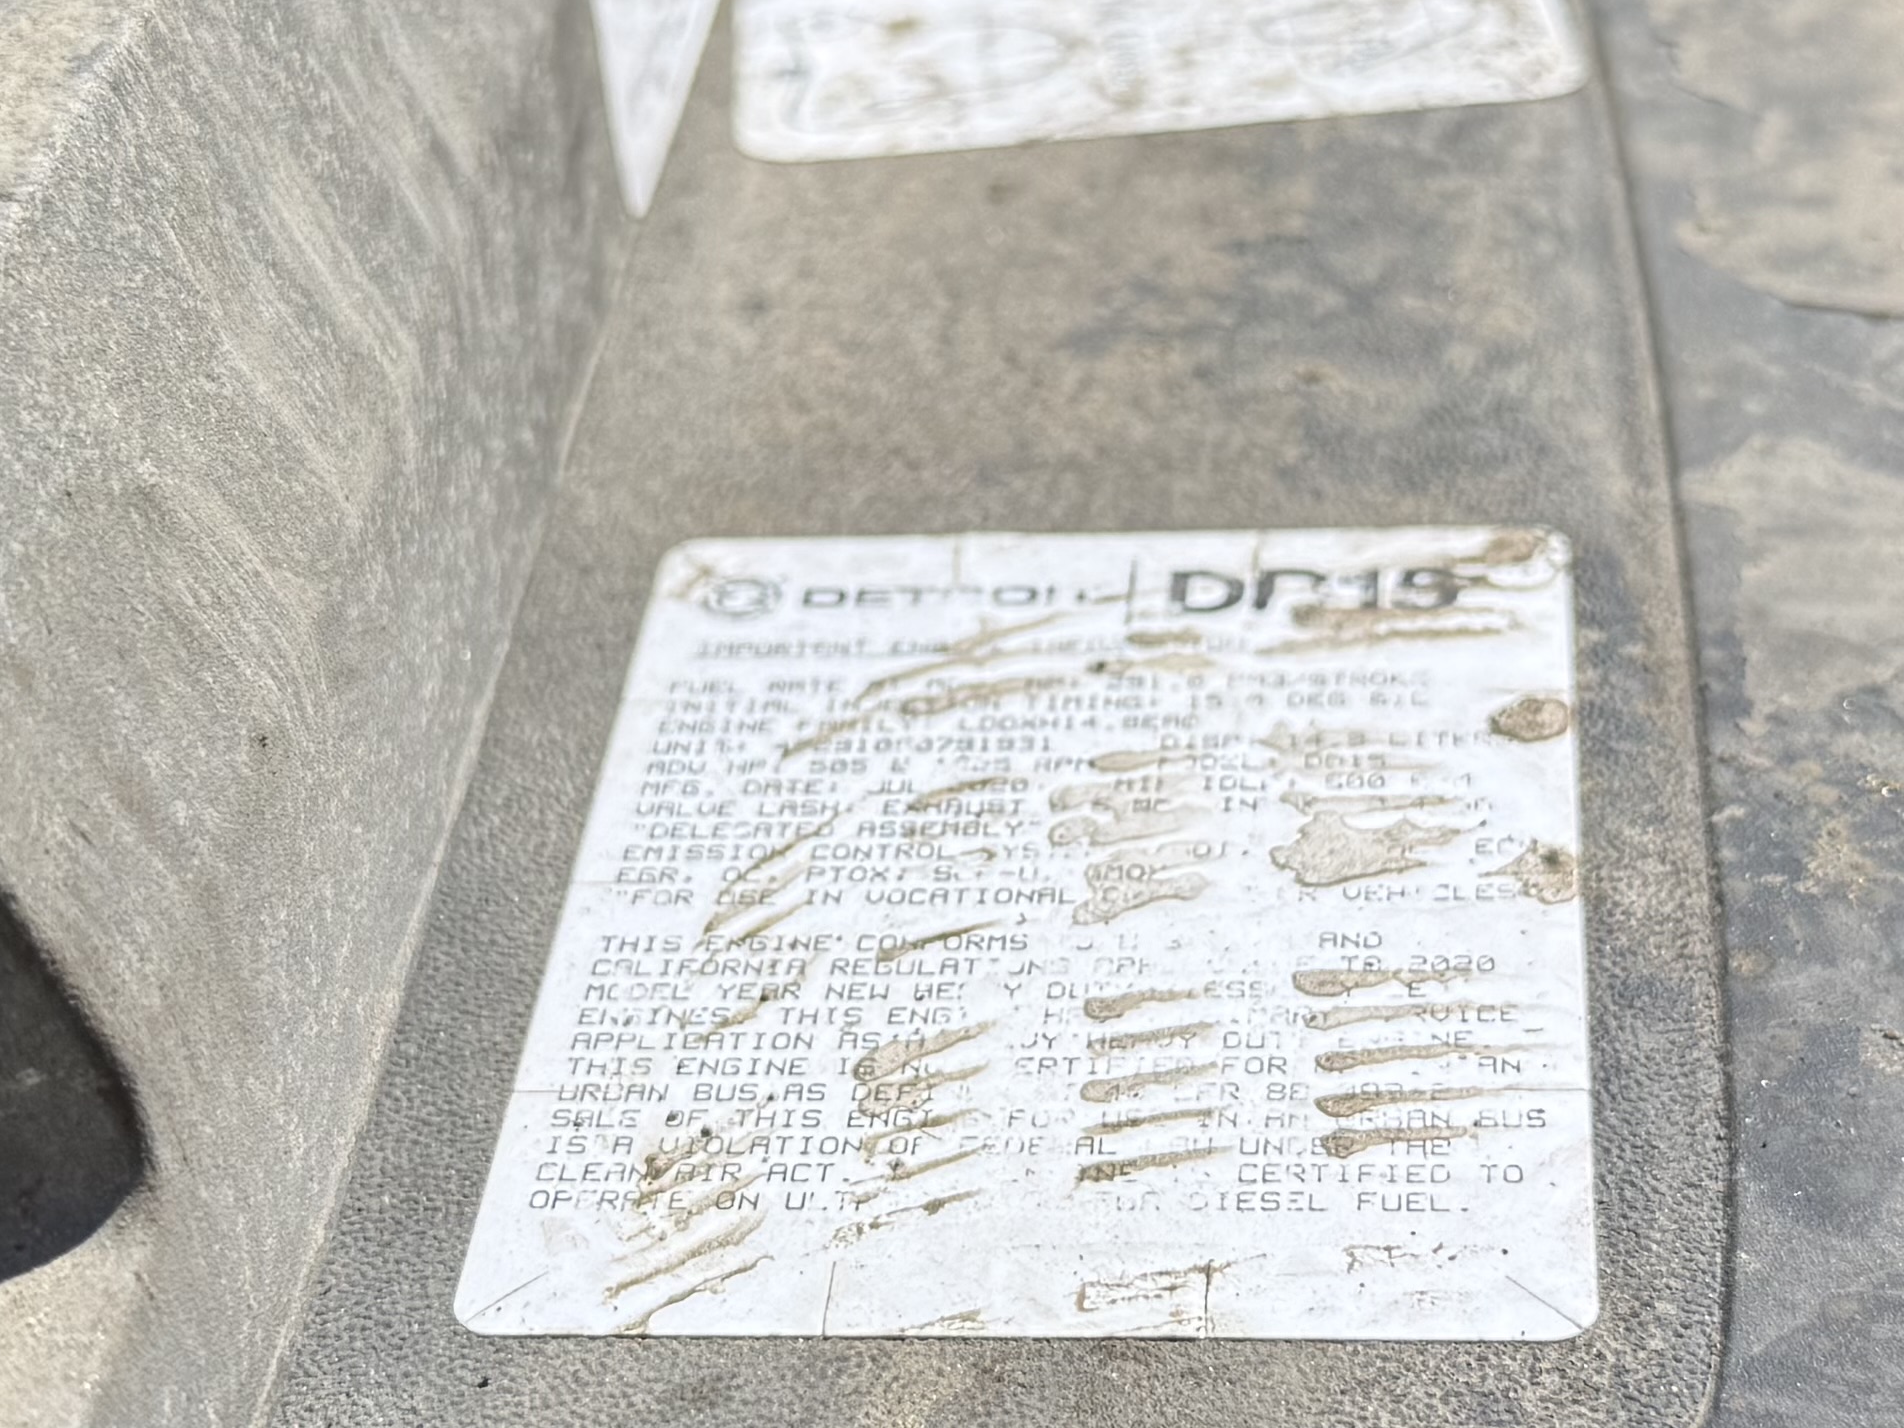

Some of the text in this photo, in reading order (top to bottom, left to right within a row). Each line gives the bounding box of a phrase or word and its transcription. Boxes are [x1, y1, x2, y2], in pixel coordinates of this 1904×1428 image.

[658, 718, 778, 734] ENGINE
[640, 778, 714, 797] MFG.
[635, 800, 737, 818] VALVE
[811, 842, 955, 861] CONTROL
[806, 887, 843, 905] IN
[865, 885, 1076, 905] VOCATIONAL
[602, 934, 684, 953] THIS
[1318, 930, 1383, 950] AND
[590, 957, 806, 976] CALIFORNIA
[1407, 954, 1495, 974] 2020
[720, 981, 802, 1001] YEAR
[824, 981, 890, 1001] NEW
[779, 1006, 863, 1025] THIS
[570, 1031, 813, 1051] APPLICATION
[568, 1057, 654, 1076] THIS
[675, 1056, 809, 1076] ENGINE
[1220, 1054, 1288, 1075] FOR
[692, 1082, 759, 1101] BUS
[781, 1081, 828, 1101] AS
[549, 1108, 642, 1129] SALE
[735, 1108, 824, 1128] THIS
[1480, 1108, 1547, 1129] BUS
[545, 1135, 588, 1155] IS
[611, 1135, 634, 1155] A
[535, 1161, 1525, 1184] CLEAN AIR ACT. CERTIFIED TO
[715, 1190, 761, 1212] ON
[1356, 1191, 1470, 1213] FUEL.
